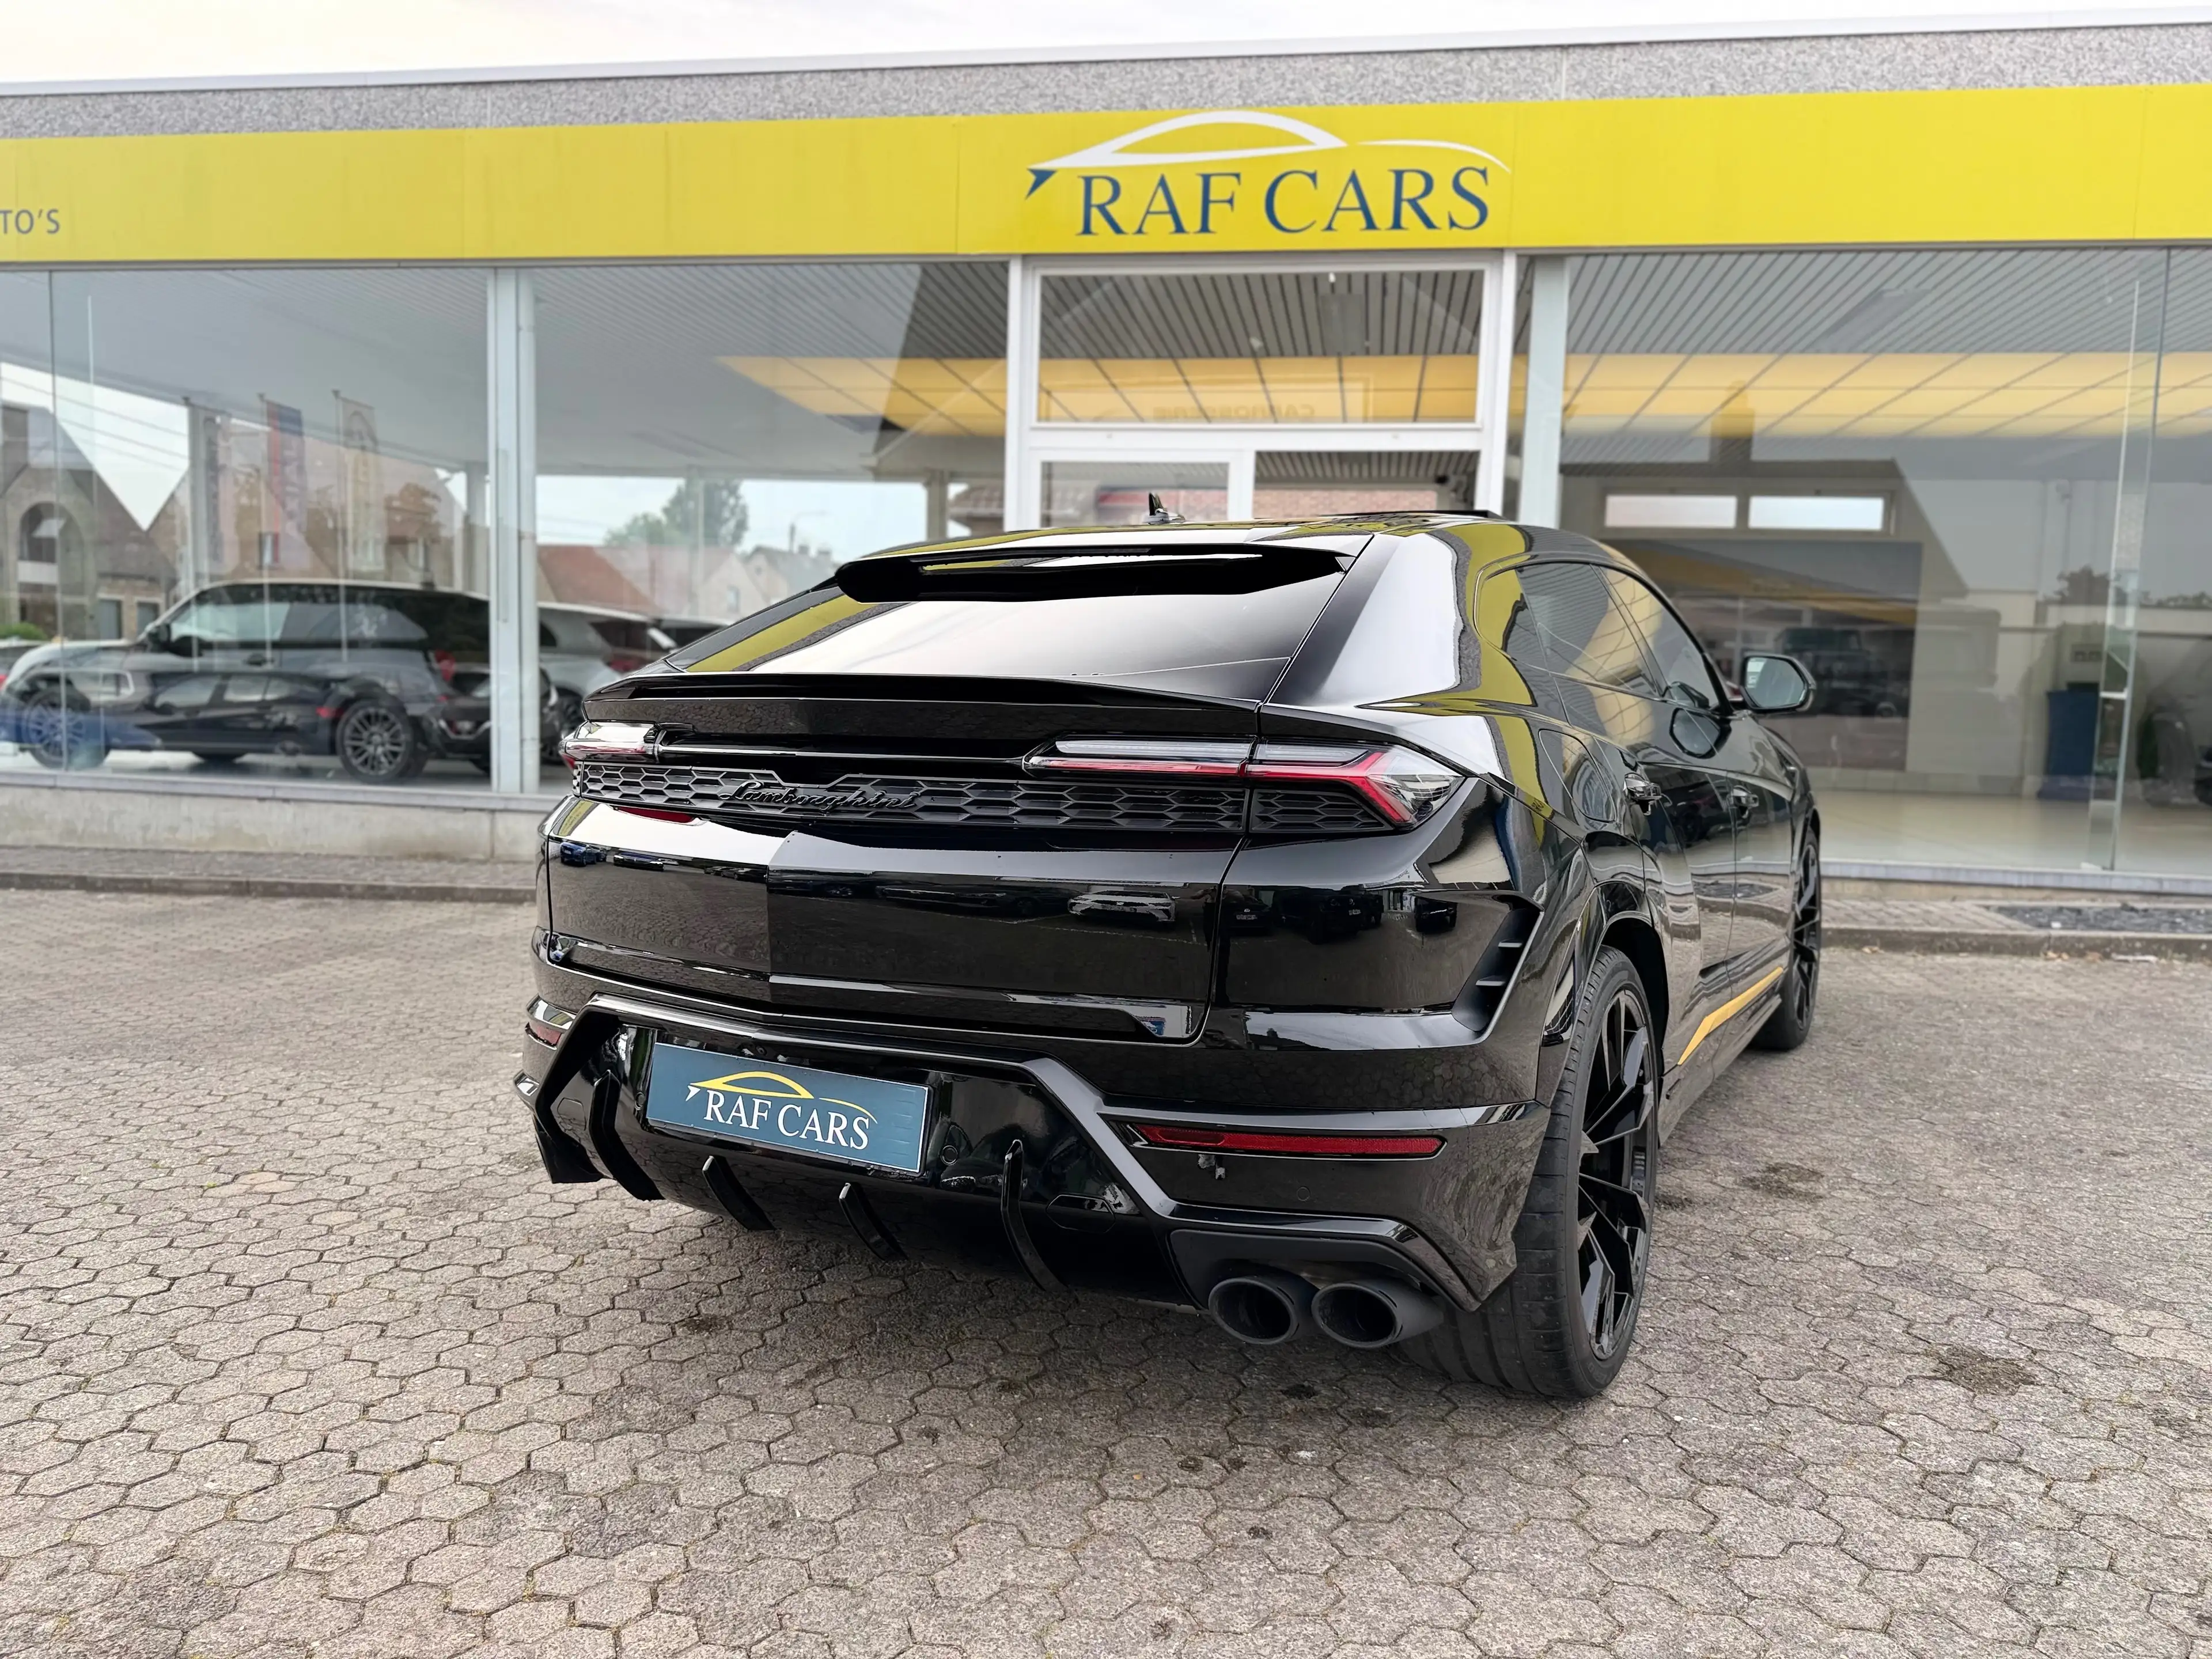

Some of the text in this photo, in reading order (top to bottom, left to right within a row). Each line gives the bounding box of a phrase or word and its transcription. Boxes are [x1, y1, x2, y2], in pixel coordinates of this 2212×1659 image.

[1077, 166, 1489, 236] RAF CARS
[719, 781, 922, 816] Lamborghini
[703, 1090, 870, 1150] RAF CARS
